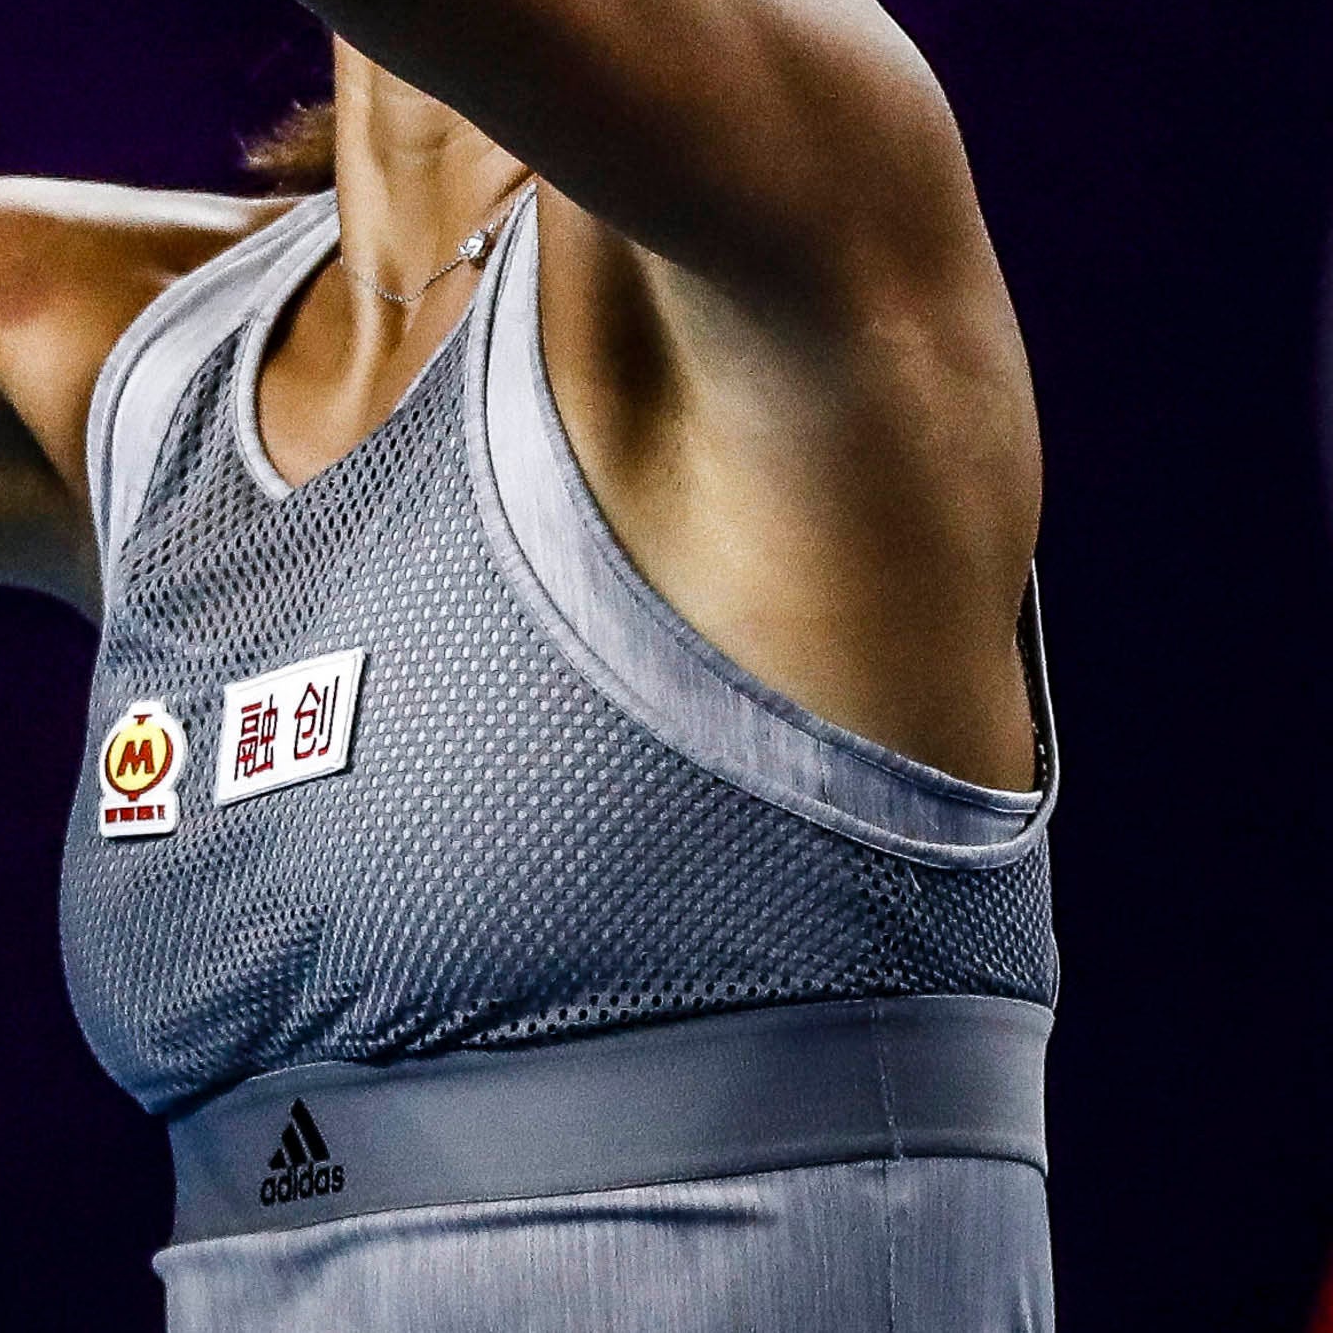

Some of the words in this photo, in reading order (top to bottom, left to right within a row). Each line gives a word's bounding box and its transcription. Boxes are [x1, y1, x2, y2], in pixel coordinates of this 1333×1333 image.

[234, 676, 340, 781] 融创
[116, 739, 156, 777] M
[259, 1162, 345, 1207] adidas
